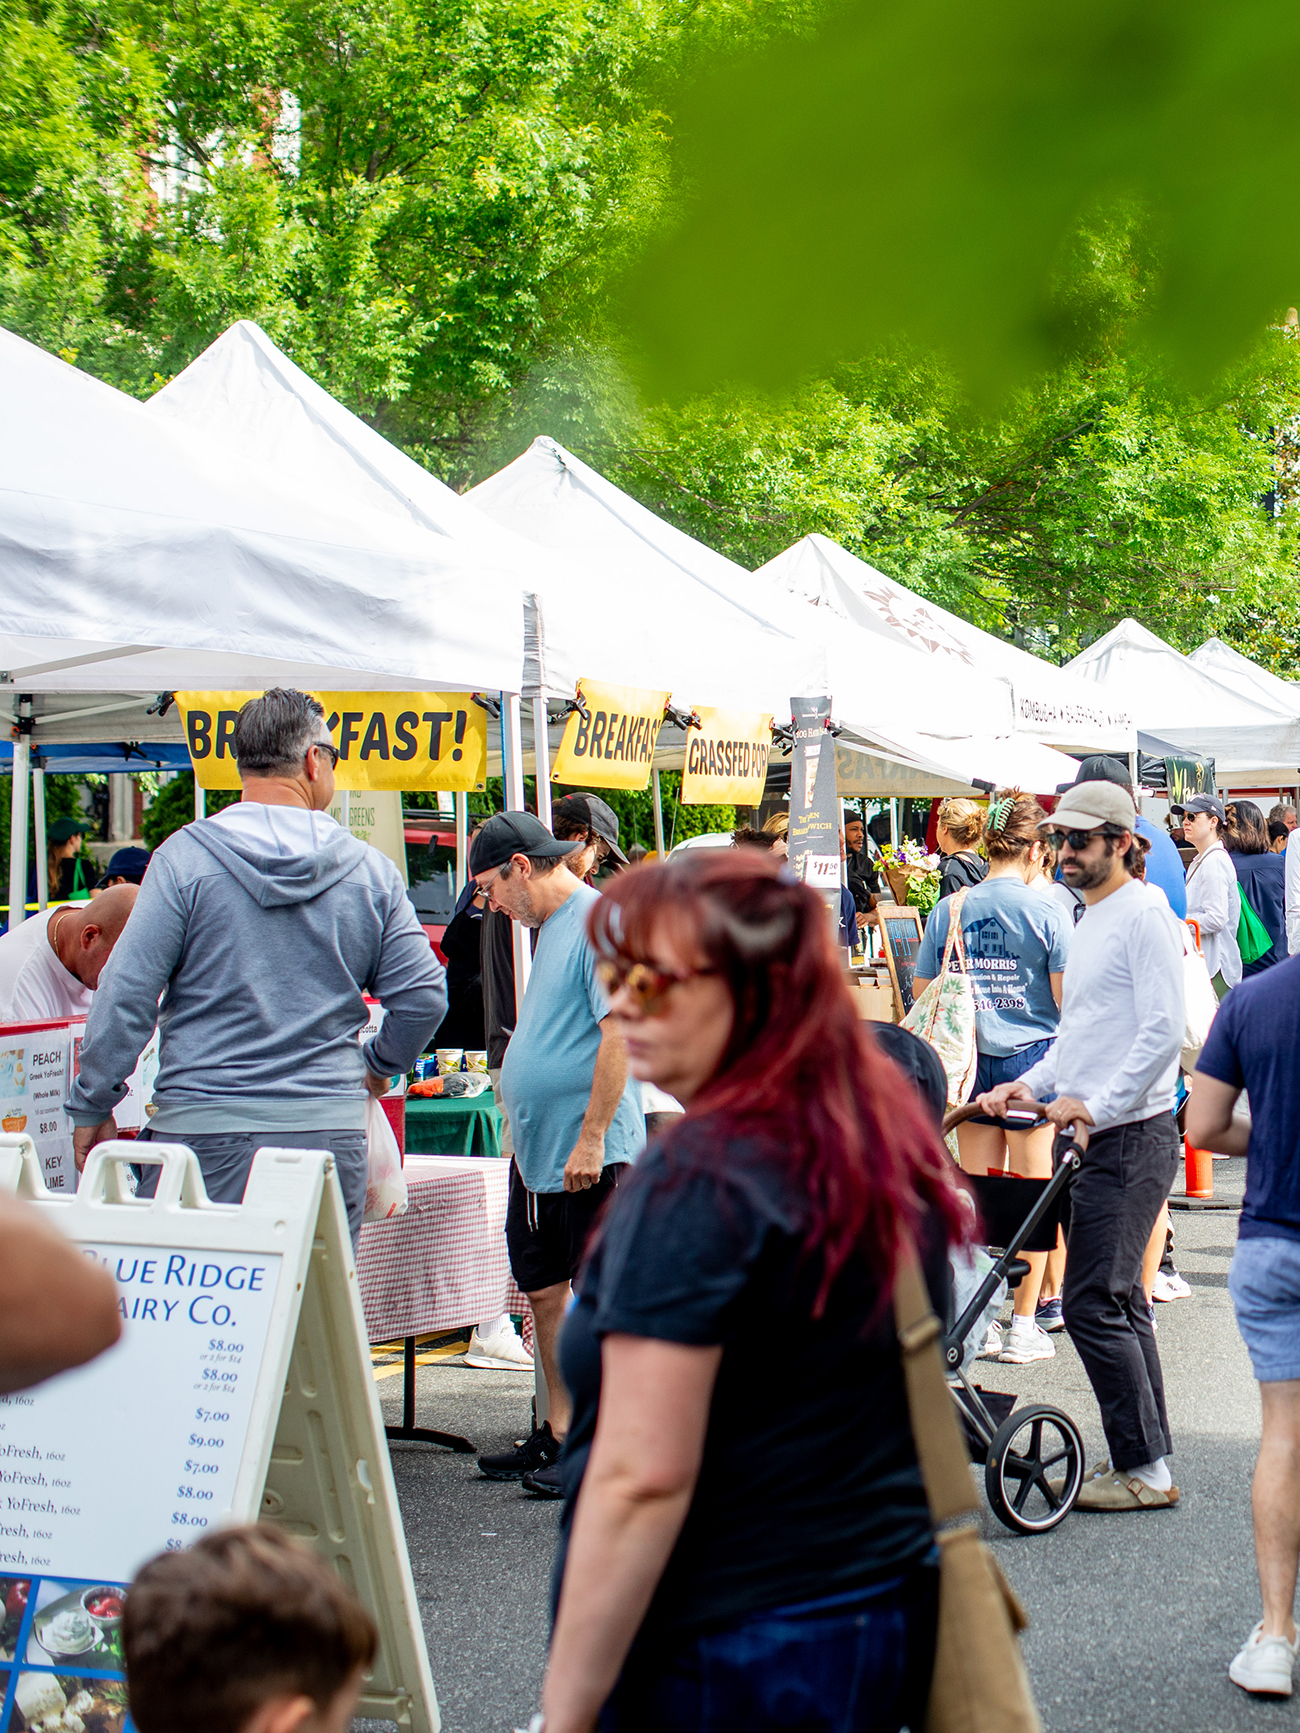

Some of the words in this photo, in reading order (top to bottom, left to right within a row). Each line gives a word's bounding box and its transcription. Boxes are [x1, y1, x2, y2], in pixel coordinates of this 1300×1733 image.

[1020, 698, 1058, 723] KOMBUCHA
[187, 710, 468, 761] BRFAST!
[573, 708, 662, 764] BREAKFAS
[688, 737, 750, 778] GRASSFED
[975, 958, 1018, 971] MORRIS
[32, 1051, 62, 1066] PEACH
[29, 1072, 43, 1081] Greek
[43, 1068, 65, 1079] YoFresh!
[33, 1091, 49, 1101] (Whole
[49, 1089, 61, 1099] Milk)
[39, 1121, 58, 1134] $8.00
[45, 1156, 63, 1170] KEY
[45, 1175, 65, 1189] LIME
[116, 1296, 180, 1322] AIRY
[208, 1338, 244, 1353] $8.00
[215, 1352, 227, 1364] for
[228, 1353, 242, 1364] $14
[202, 1368, 238, 1383] $8.00
[209, 1382, 221, 1393] for
[221, 1383, 236, 1393] $14
[195, 1407, 230, 1423] $7.00
[188, 1433, 225, 1448] $9.00
[0, 1444, 43, 1461] oFresh,
[45, 1452, 66, 1461] 16oz
[184, 1459, 219, 1475] $7.00
[51, 1478, 72, 1488] 16oz
[177, 1485, 214, 1501] $8.00
[7, 1497, 58, 1515] YoFresh,
[60, 1505, 81, 1515] 16oz
[171, 1511, 208, 1527] $8.00
[32, 1529, 53, 1540] 16oz
[30, 1556, 51, 1567] 16oz
